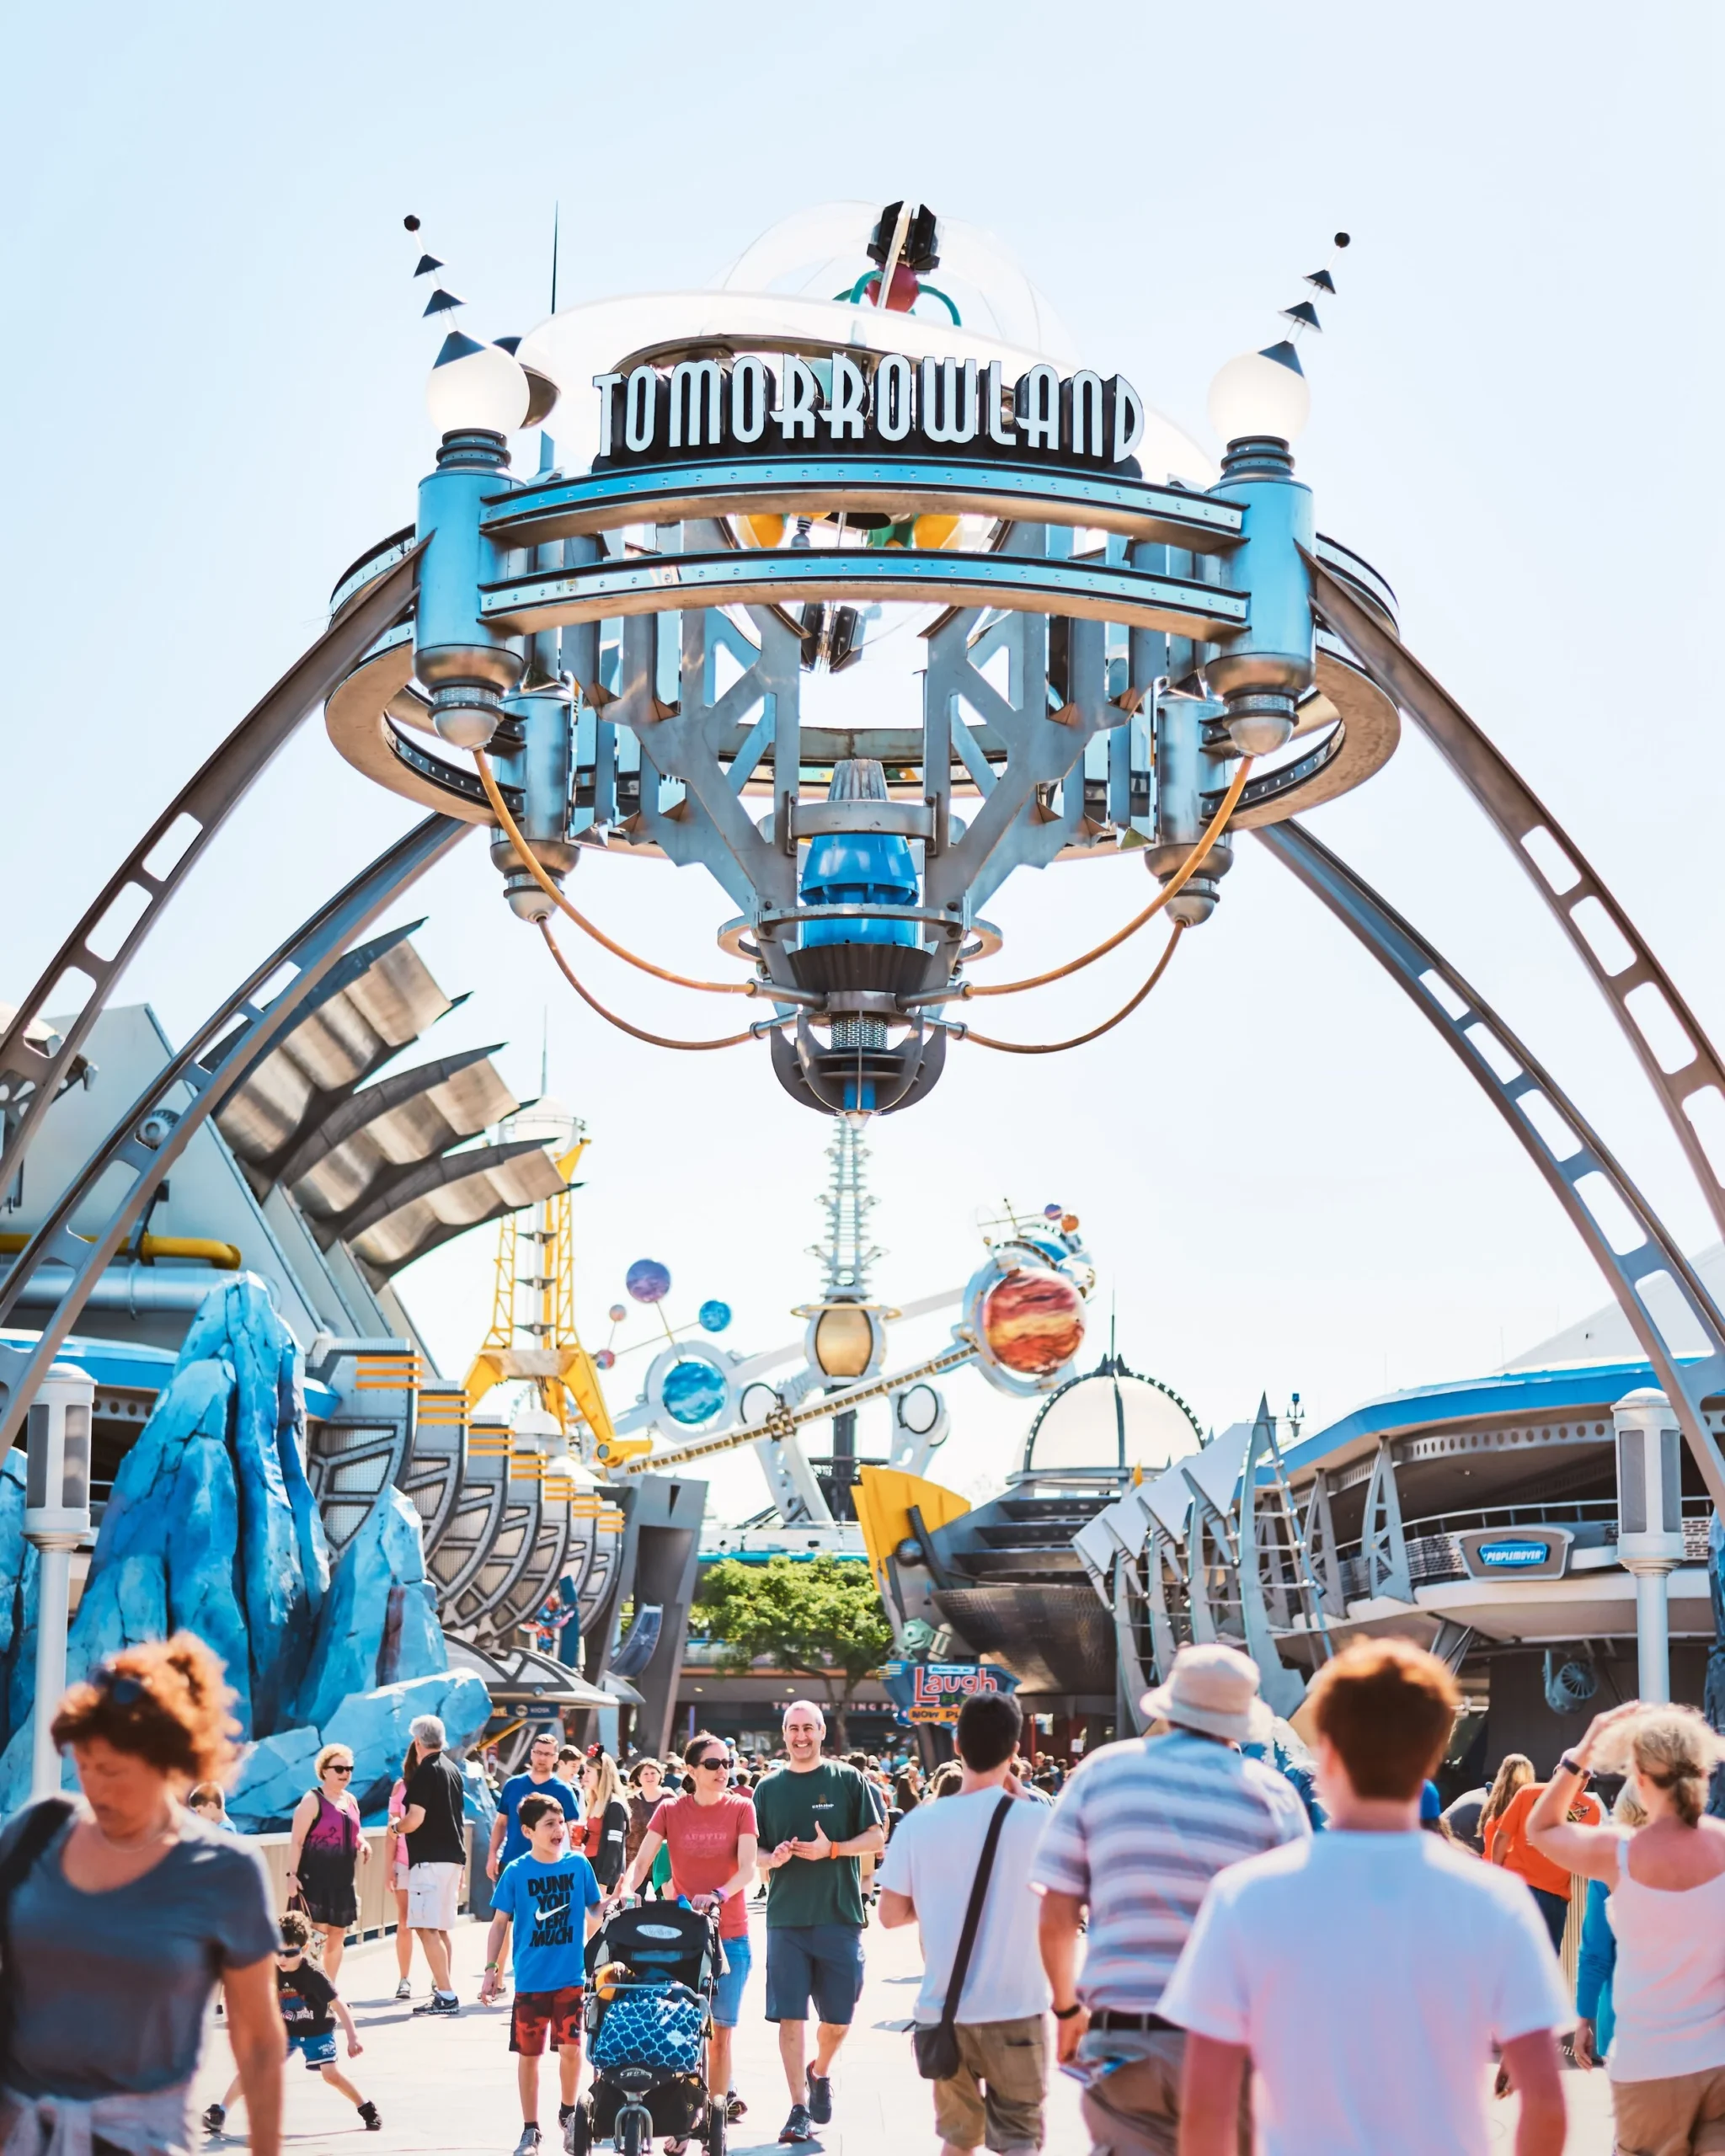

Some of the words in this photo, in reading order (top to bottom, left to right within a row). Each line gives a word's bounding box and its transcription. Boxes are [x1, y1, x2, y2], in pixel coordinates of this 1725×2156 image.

[592, 351, 1145, 463] TOMORROWLAND
[1486, 1550, 1541, 1562] PEOPLEMOVER
[914, 1667, 997, 1703] Laugh
[527, 1873, 574, 1897] DUNK
[537, 1892, 570, 1913] YOU
[534, 1908, 571, 1930] VERY
[529, 1926, 574, 1947] MUCH
